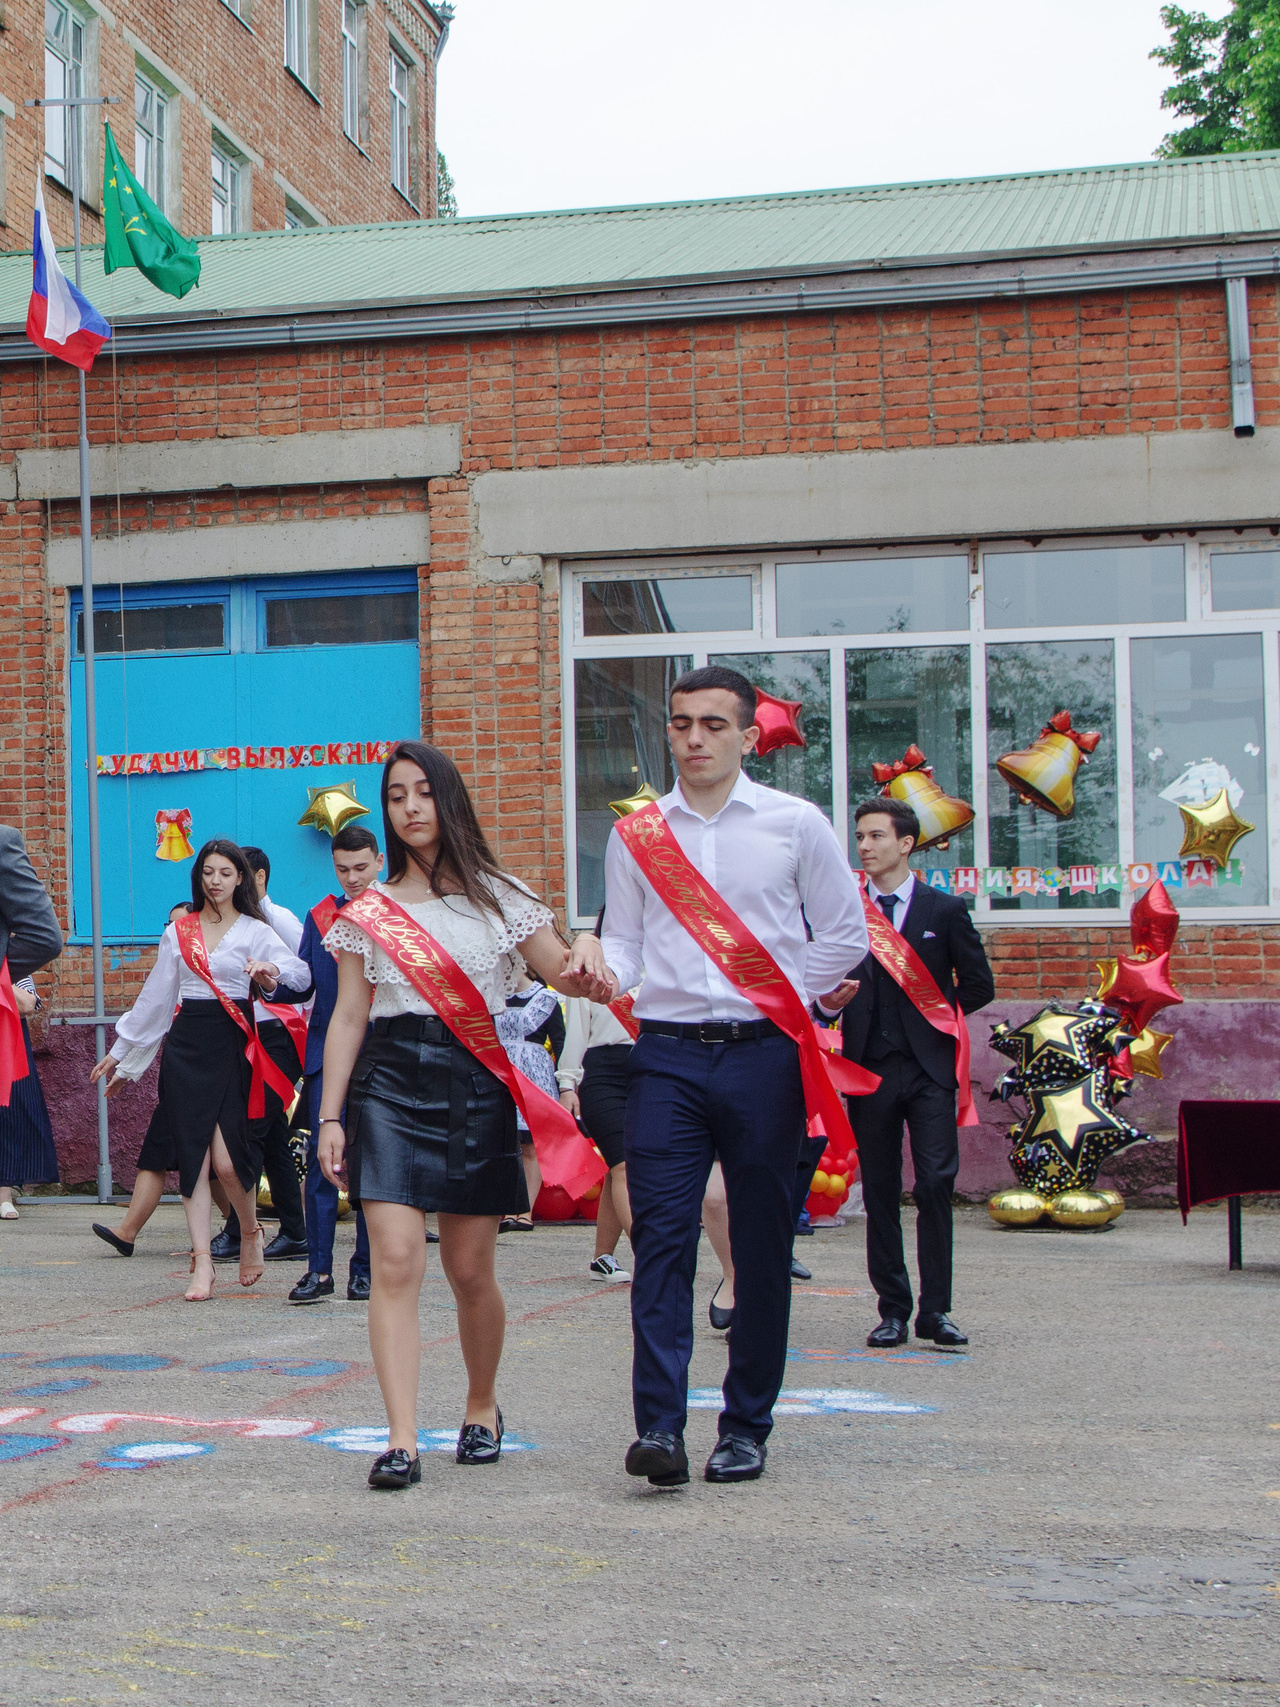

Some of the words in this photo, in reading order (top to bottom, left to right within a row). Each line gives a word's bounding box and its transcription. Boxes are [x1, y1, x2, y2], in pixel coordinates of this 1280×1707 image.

[111, 749, 204, 775] УДАЧИ,
[647, 845, 737, 949] Выпускник
[719, 946, 781, 991] 2021
[1071, 861, 1232, 888] ШКОЛА!
[375, 915, 467, 1013] Выпускник
[451, 1010, 499, 1053] 2021
[865, 916, 921, 984] Выпускник
[910, 983, 947, 1012] 2021
